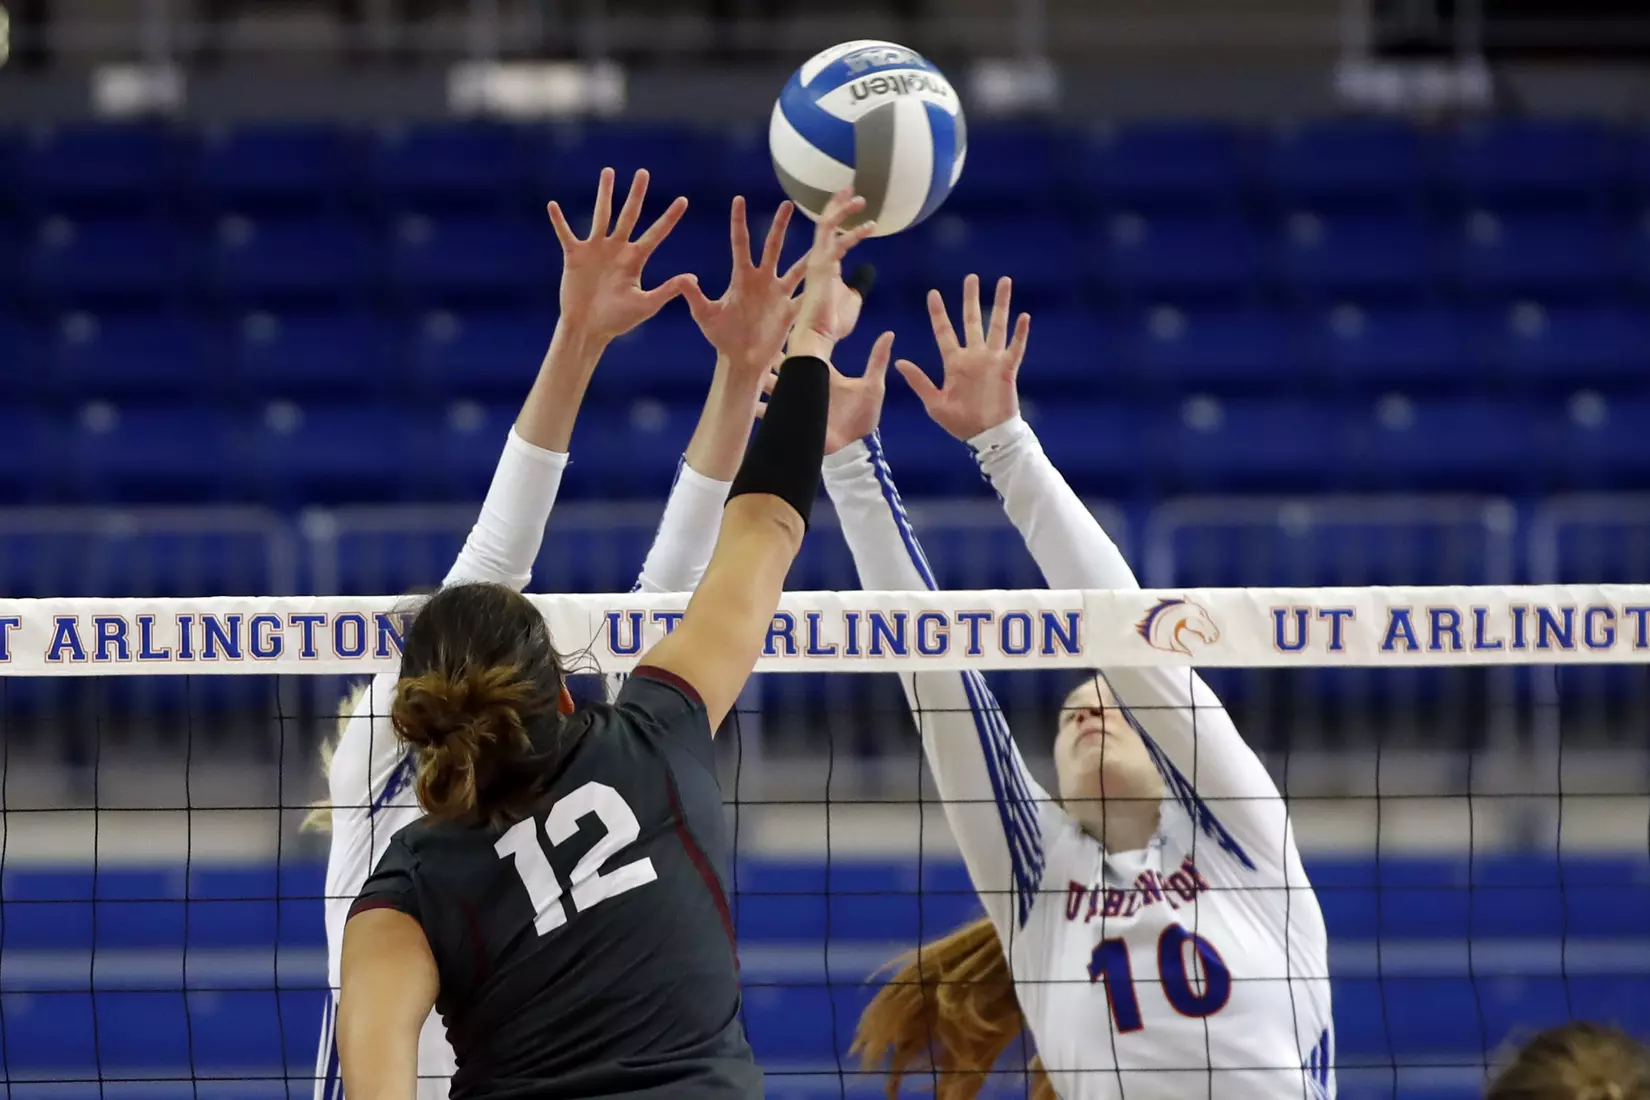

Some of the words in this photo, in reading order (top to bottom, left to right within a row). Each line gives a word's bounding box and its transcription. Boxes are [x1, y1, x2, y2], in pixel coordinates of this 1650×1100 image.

[851, 74, 947, 101] molten
[45, 612, 414, 663] ARLINGTON
[761, 608, 1084, 658] RLINGTON
[1270, 606, 1356, 653] UT
[493, 781, 658, 937] 12
[1087, 922, 1231, 1034] 10
